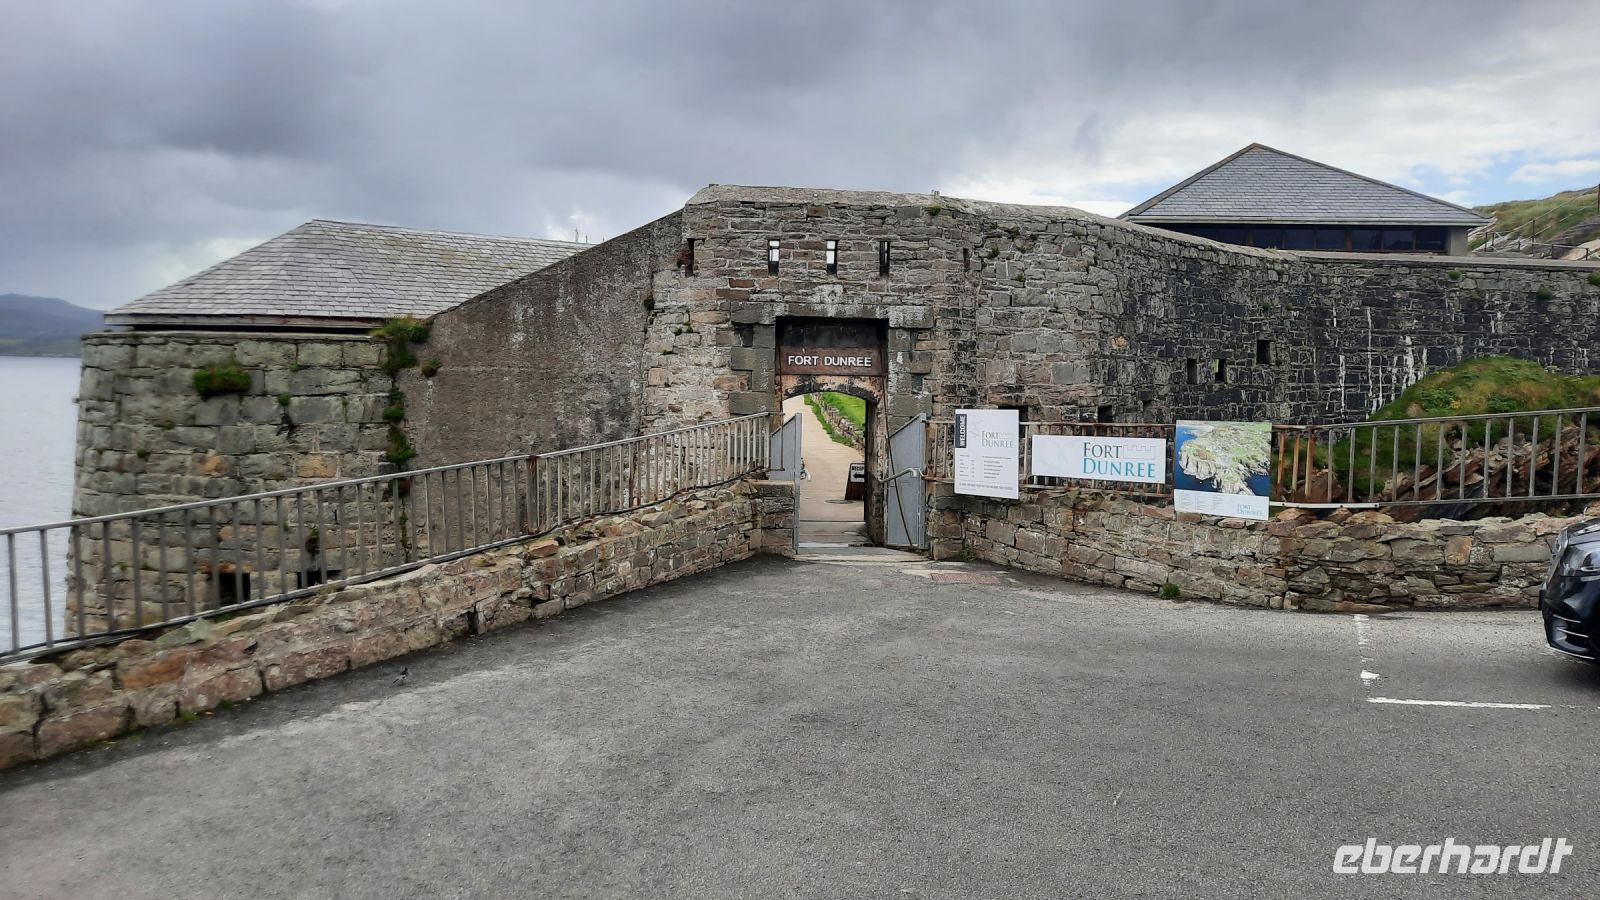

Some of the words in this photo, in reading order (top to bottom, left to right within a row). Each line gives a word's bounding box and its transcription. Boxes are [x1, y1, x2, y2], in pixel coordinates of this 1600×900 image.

[788, 355, 819, 366] FORT
[824, 356, 872, 367] DUNREE
[1083, 442, 1123, 459] FORT
[1083, 457, 1156, 478] DUNREE
